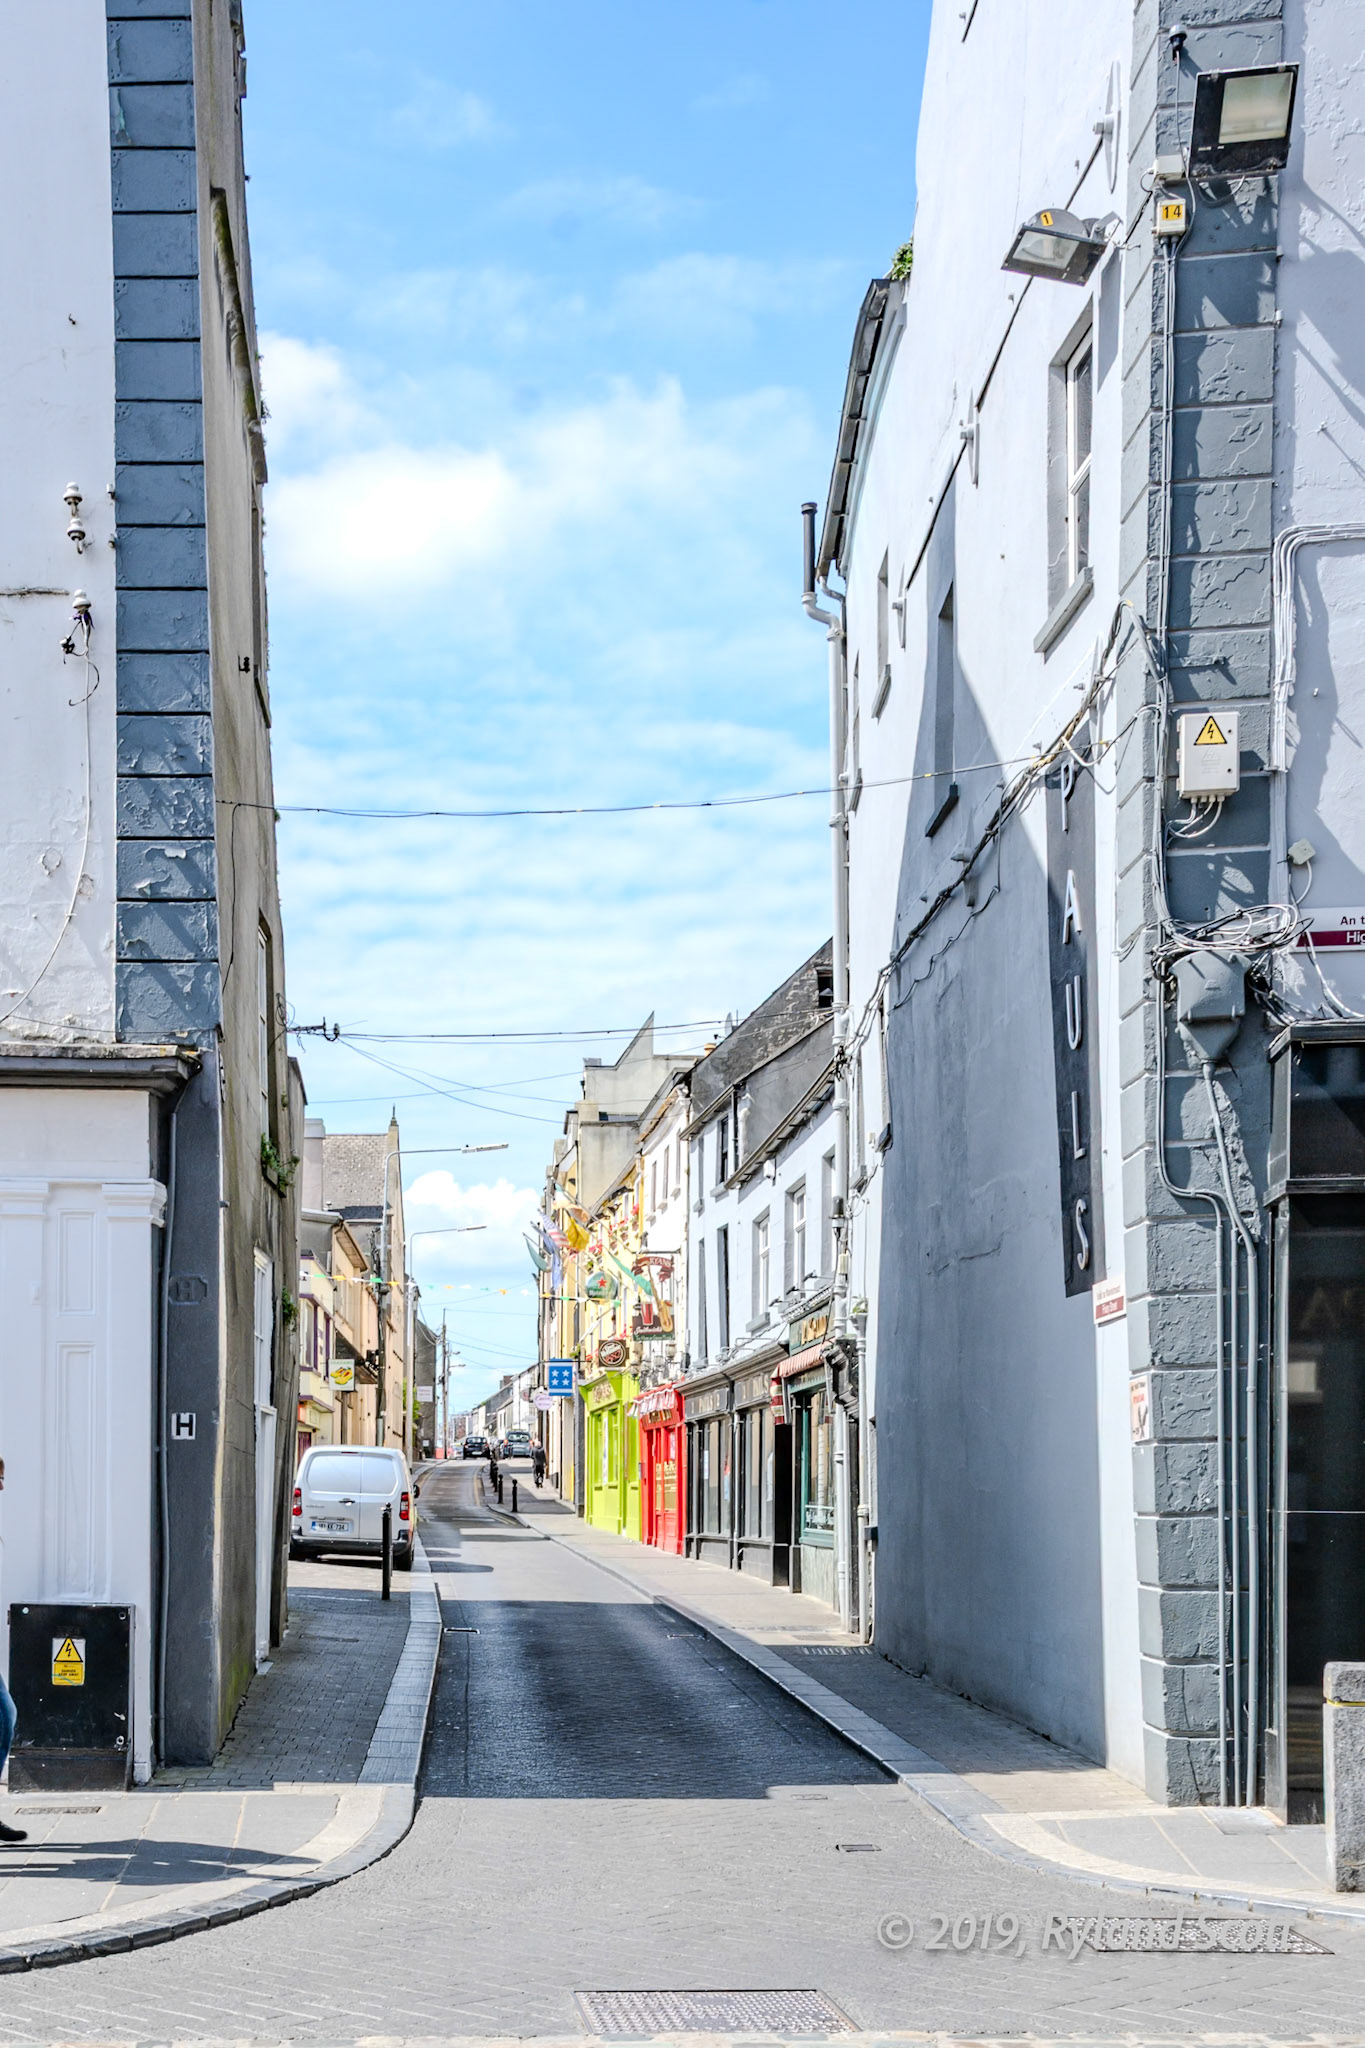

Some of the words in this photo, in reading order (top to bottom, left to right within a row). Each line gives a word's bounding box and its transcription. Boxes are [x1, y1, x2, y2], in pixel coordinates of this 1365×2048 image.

[1164, 205, 1181, 218] 14
[1043, 213, 1050, 224] 1
[1340, 915, 1356, 926] An
[176, 1414, 193, 1436] H
